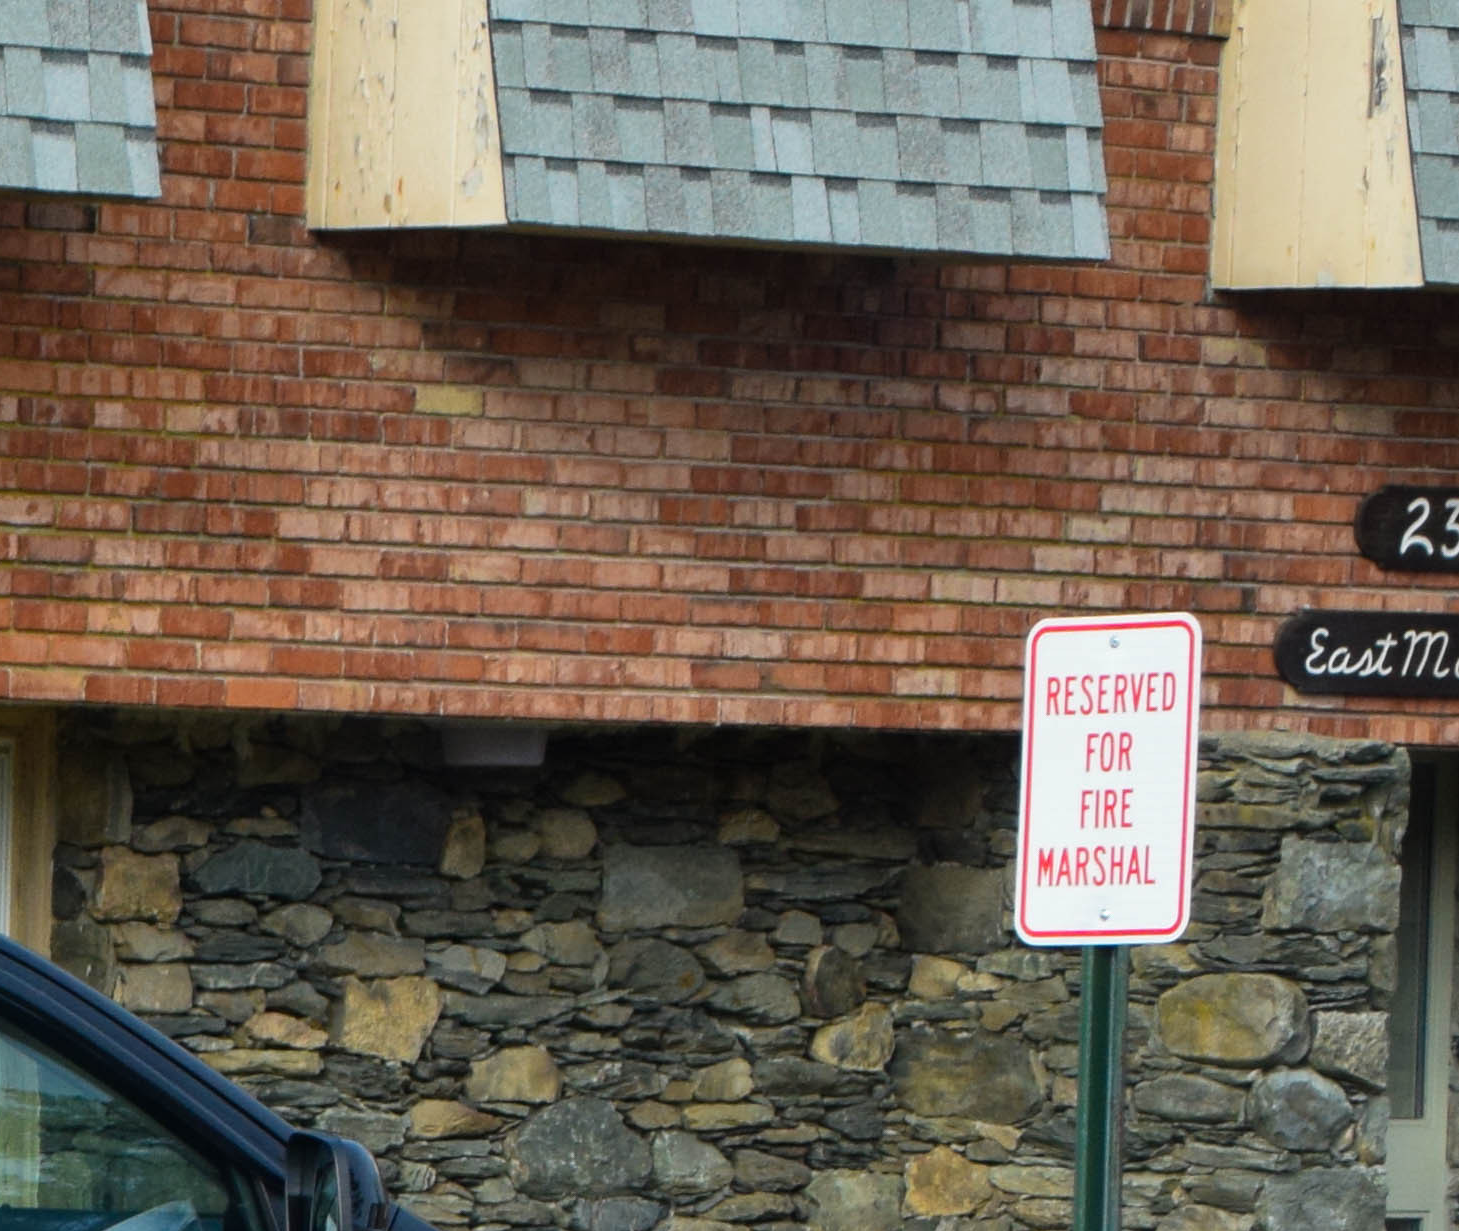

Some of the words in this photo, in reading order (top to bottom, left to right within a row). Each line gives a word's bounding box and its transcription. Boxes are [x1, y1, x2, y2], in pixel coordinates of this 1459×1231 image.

[1305, 627, 1398, 677] East
[1400, 629, 1459, 679] M
[1046, 672, 1177, 716] RESERVED
[1085, 732, 1133, 771] FOR
[1080, 789, 1133, 829] FIRE
[1037, 846, 1156, 887] MARSHAL
